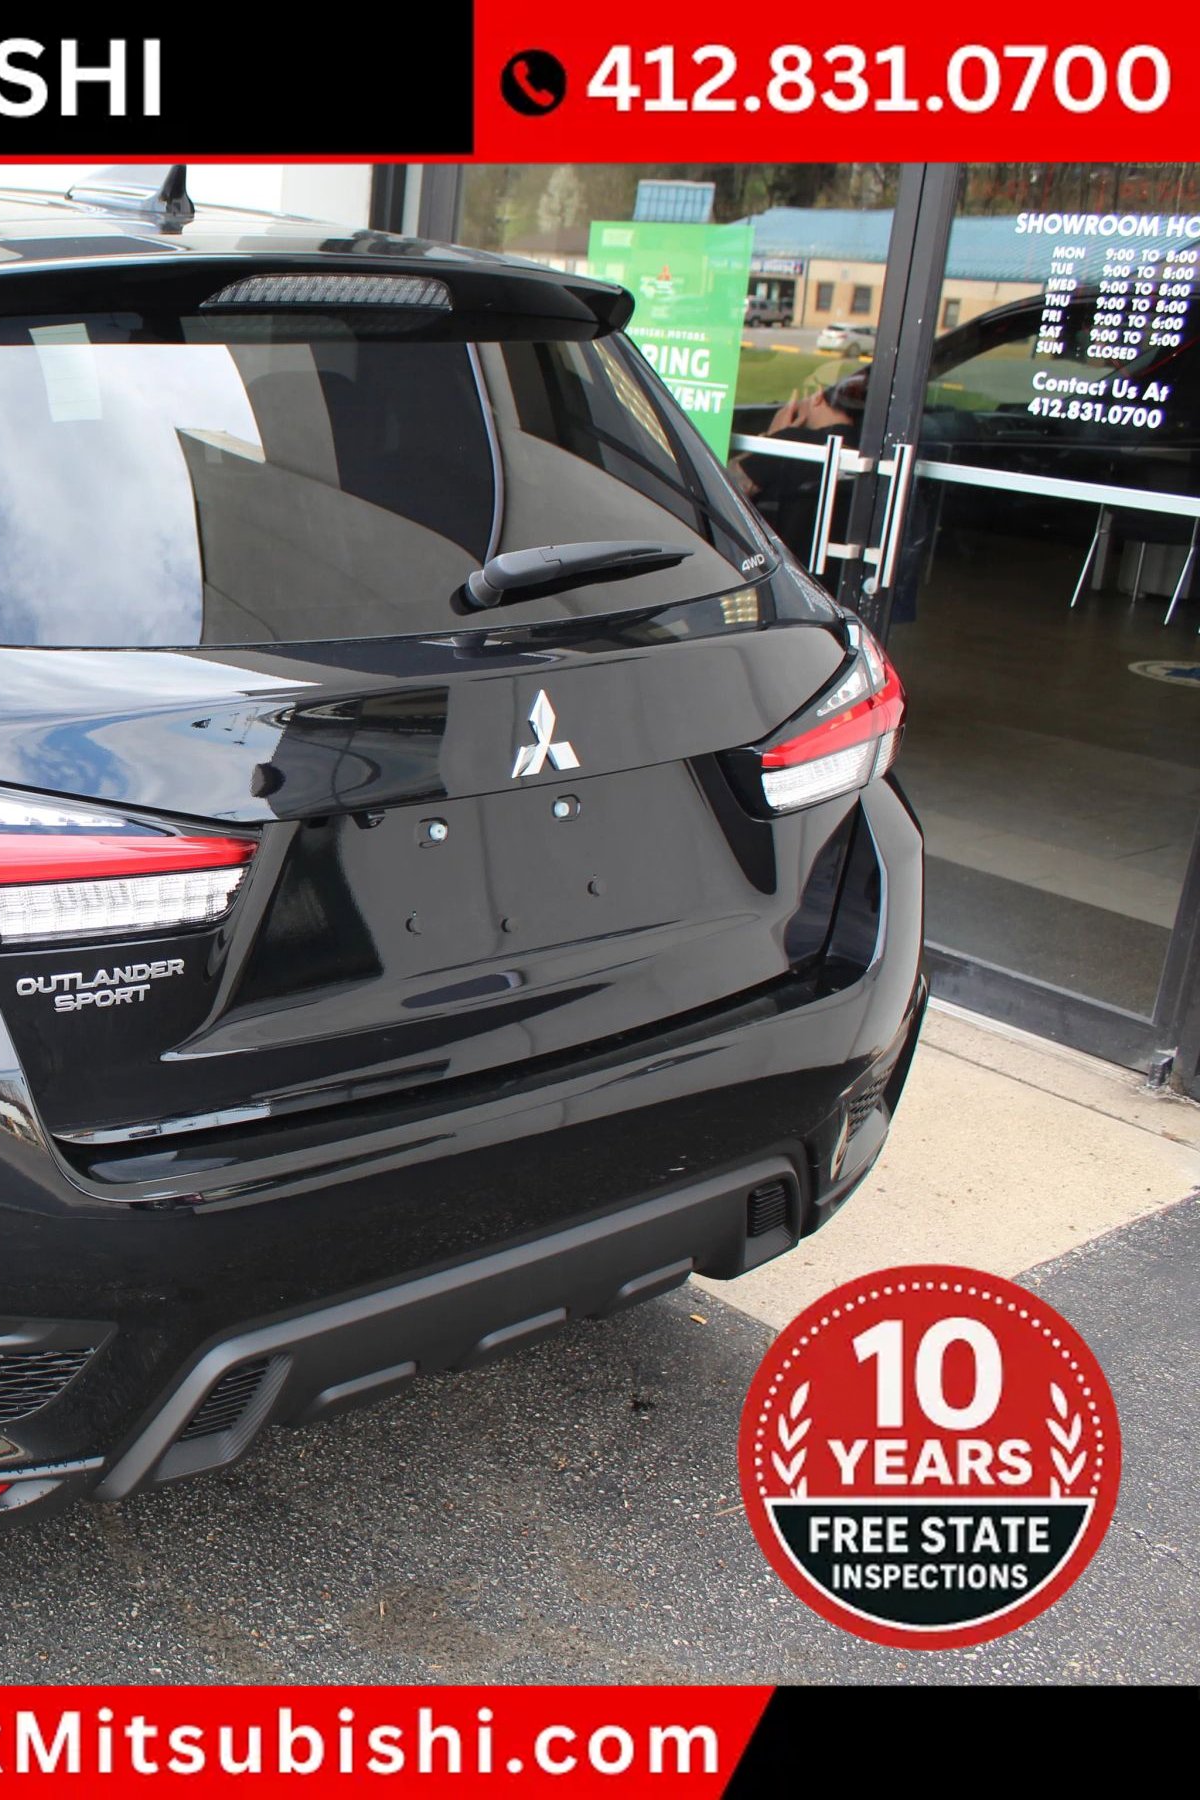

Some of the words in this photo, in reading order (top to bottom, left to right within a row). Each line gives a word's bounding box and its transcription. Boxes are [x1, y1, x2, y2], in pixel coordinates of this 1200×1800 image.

[1015, 213, 1159, 236] SHOWROOM
[1053, 246, 1086, 259] MON
[1105, 248, 1135, 261] 9:00
[1141, 250, 1159, 262] TO
[1166, 250, 1198, 263] 8:00
[1050, 262, 1073, 275] TUE
[1102, 264, 1131, 278] 9:00
[1137, 266, 1155, 278] TO
[1162, 267, 1195, 280] 8:00
[1048, 278, 1077, 291] WED
[1099, 281, 1128, 294] 9:00
[1134, 282, 1153, 295] TO
[1159, 284, 1191, 297] 8:00
[1044, 294, 1071, 307] THU
[1096, 297, 1126, 311] 9:00
[1131, 298, 1150, 312] TO
[1155, 300, 1188, 314] 8:00
[1041, 309, 1063, 322] FRI
[1093, 313, 1122, 326] 9:00
[1127, 315, 1147, 328] TO
[1151, 317, 1184, 331] 6:00
[1039, 325, 1063, 338] SAT
[1089, 329, 1119, 343] 9:00
[1123, 330, 1142, 344] TO
[1149, 333, 1181, 347] 5:00
[1036, 341, 1064, 354] SUN
[1087, 345, 1138, 360] CLOSED
[1032, 371, 1107, 396] Contact
[1112, 379, 1138, 400] Us
[1142, 382, 1169, 402] At
[1027, 397, 1162, 429] 412.831.0700
[742, 553, 765, 571] 4WD
[16, 958, 185, 996] OUTLANDER
[54, 984, 151, 1013] SPORT
